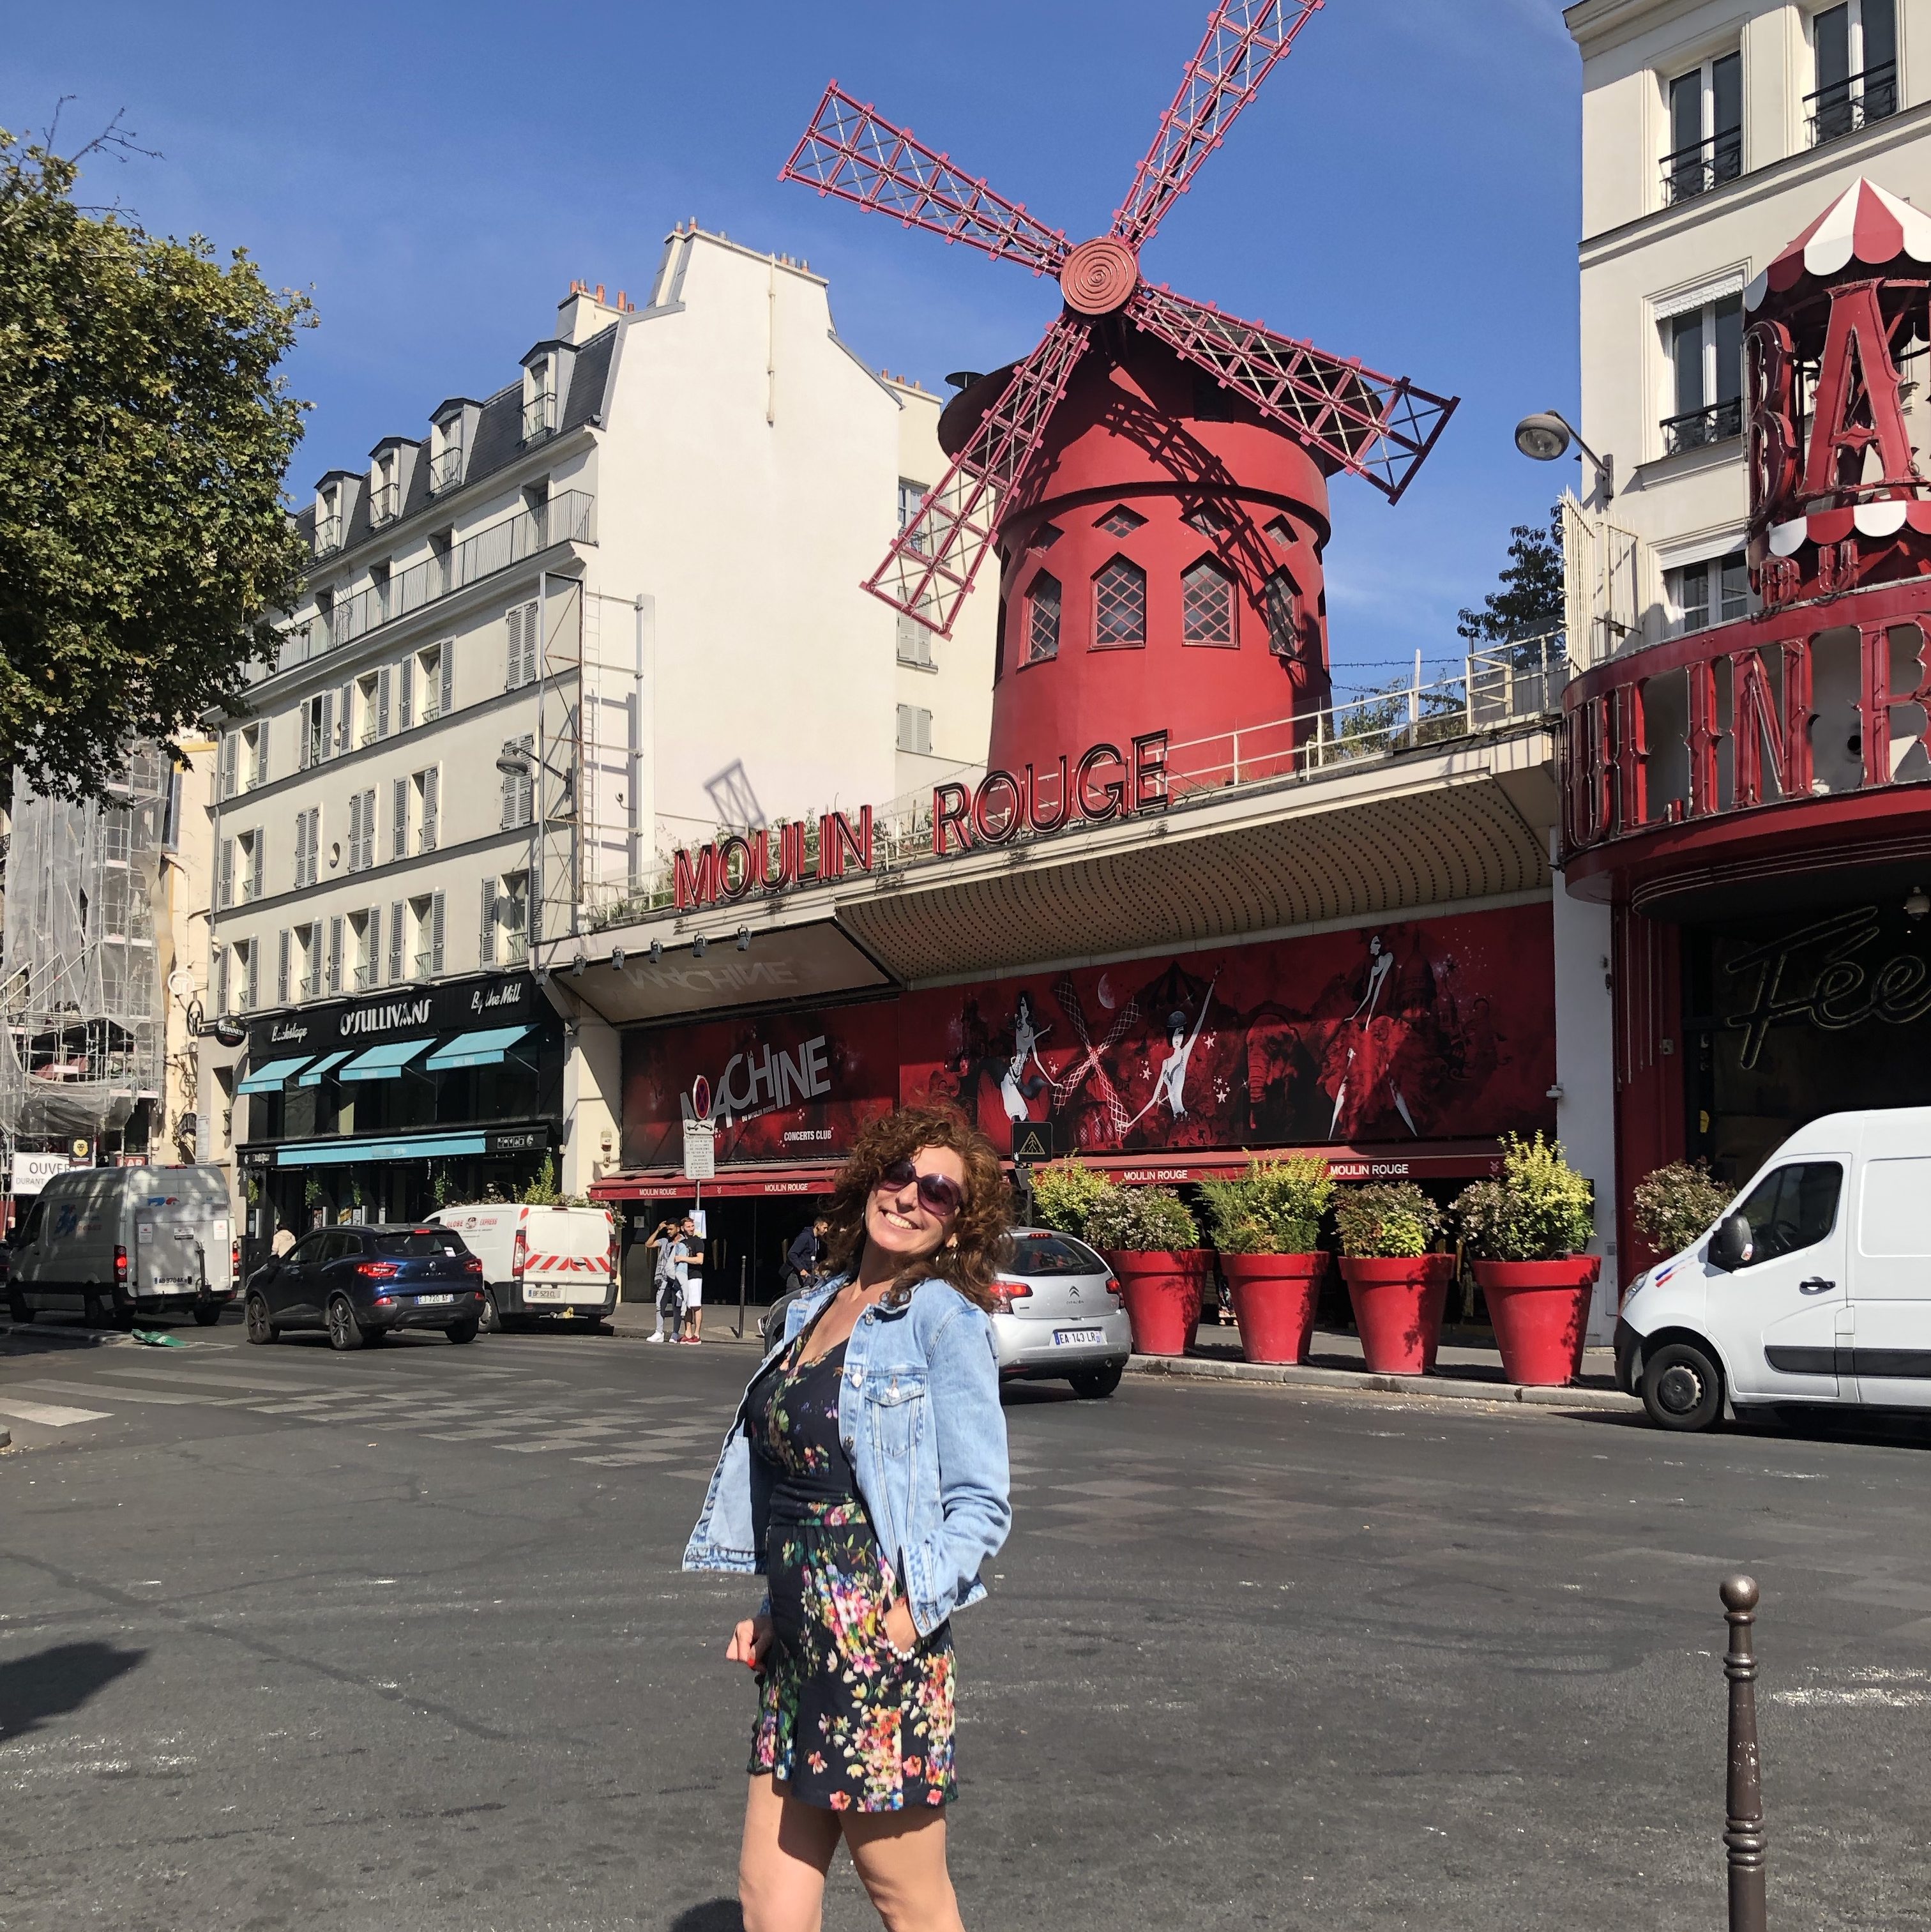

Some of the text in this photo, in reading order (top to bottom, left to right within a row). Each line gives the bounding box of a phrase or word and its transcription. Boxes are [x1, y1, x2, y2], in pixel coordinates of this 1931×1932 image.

[1744, 278, 1931, 530] BA
[1554, 637, 1814, 849] ULIN
[674, 729, 1173, 910] MOULIN ROUGE
[485, 987, 500, 1007] the
[500, 982, 522, 1005] Mill
[340, 999, 432, 1036] O'SULLIVANS
[784, 1130, 832, 1141] CONCERTS CLUB
[1124, 1170, 1188, 1180] MOULIN ROUGE
[1329, 1164, 1409, 1176] MOULIN ROUGE
[1060, 1332, 1096, 1344] EA 143 LR
